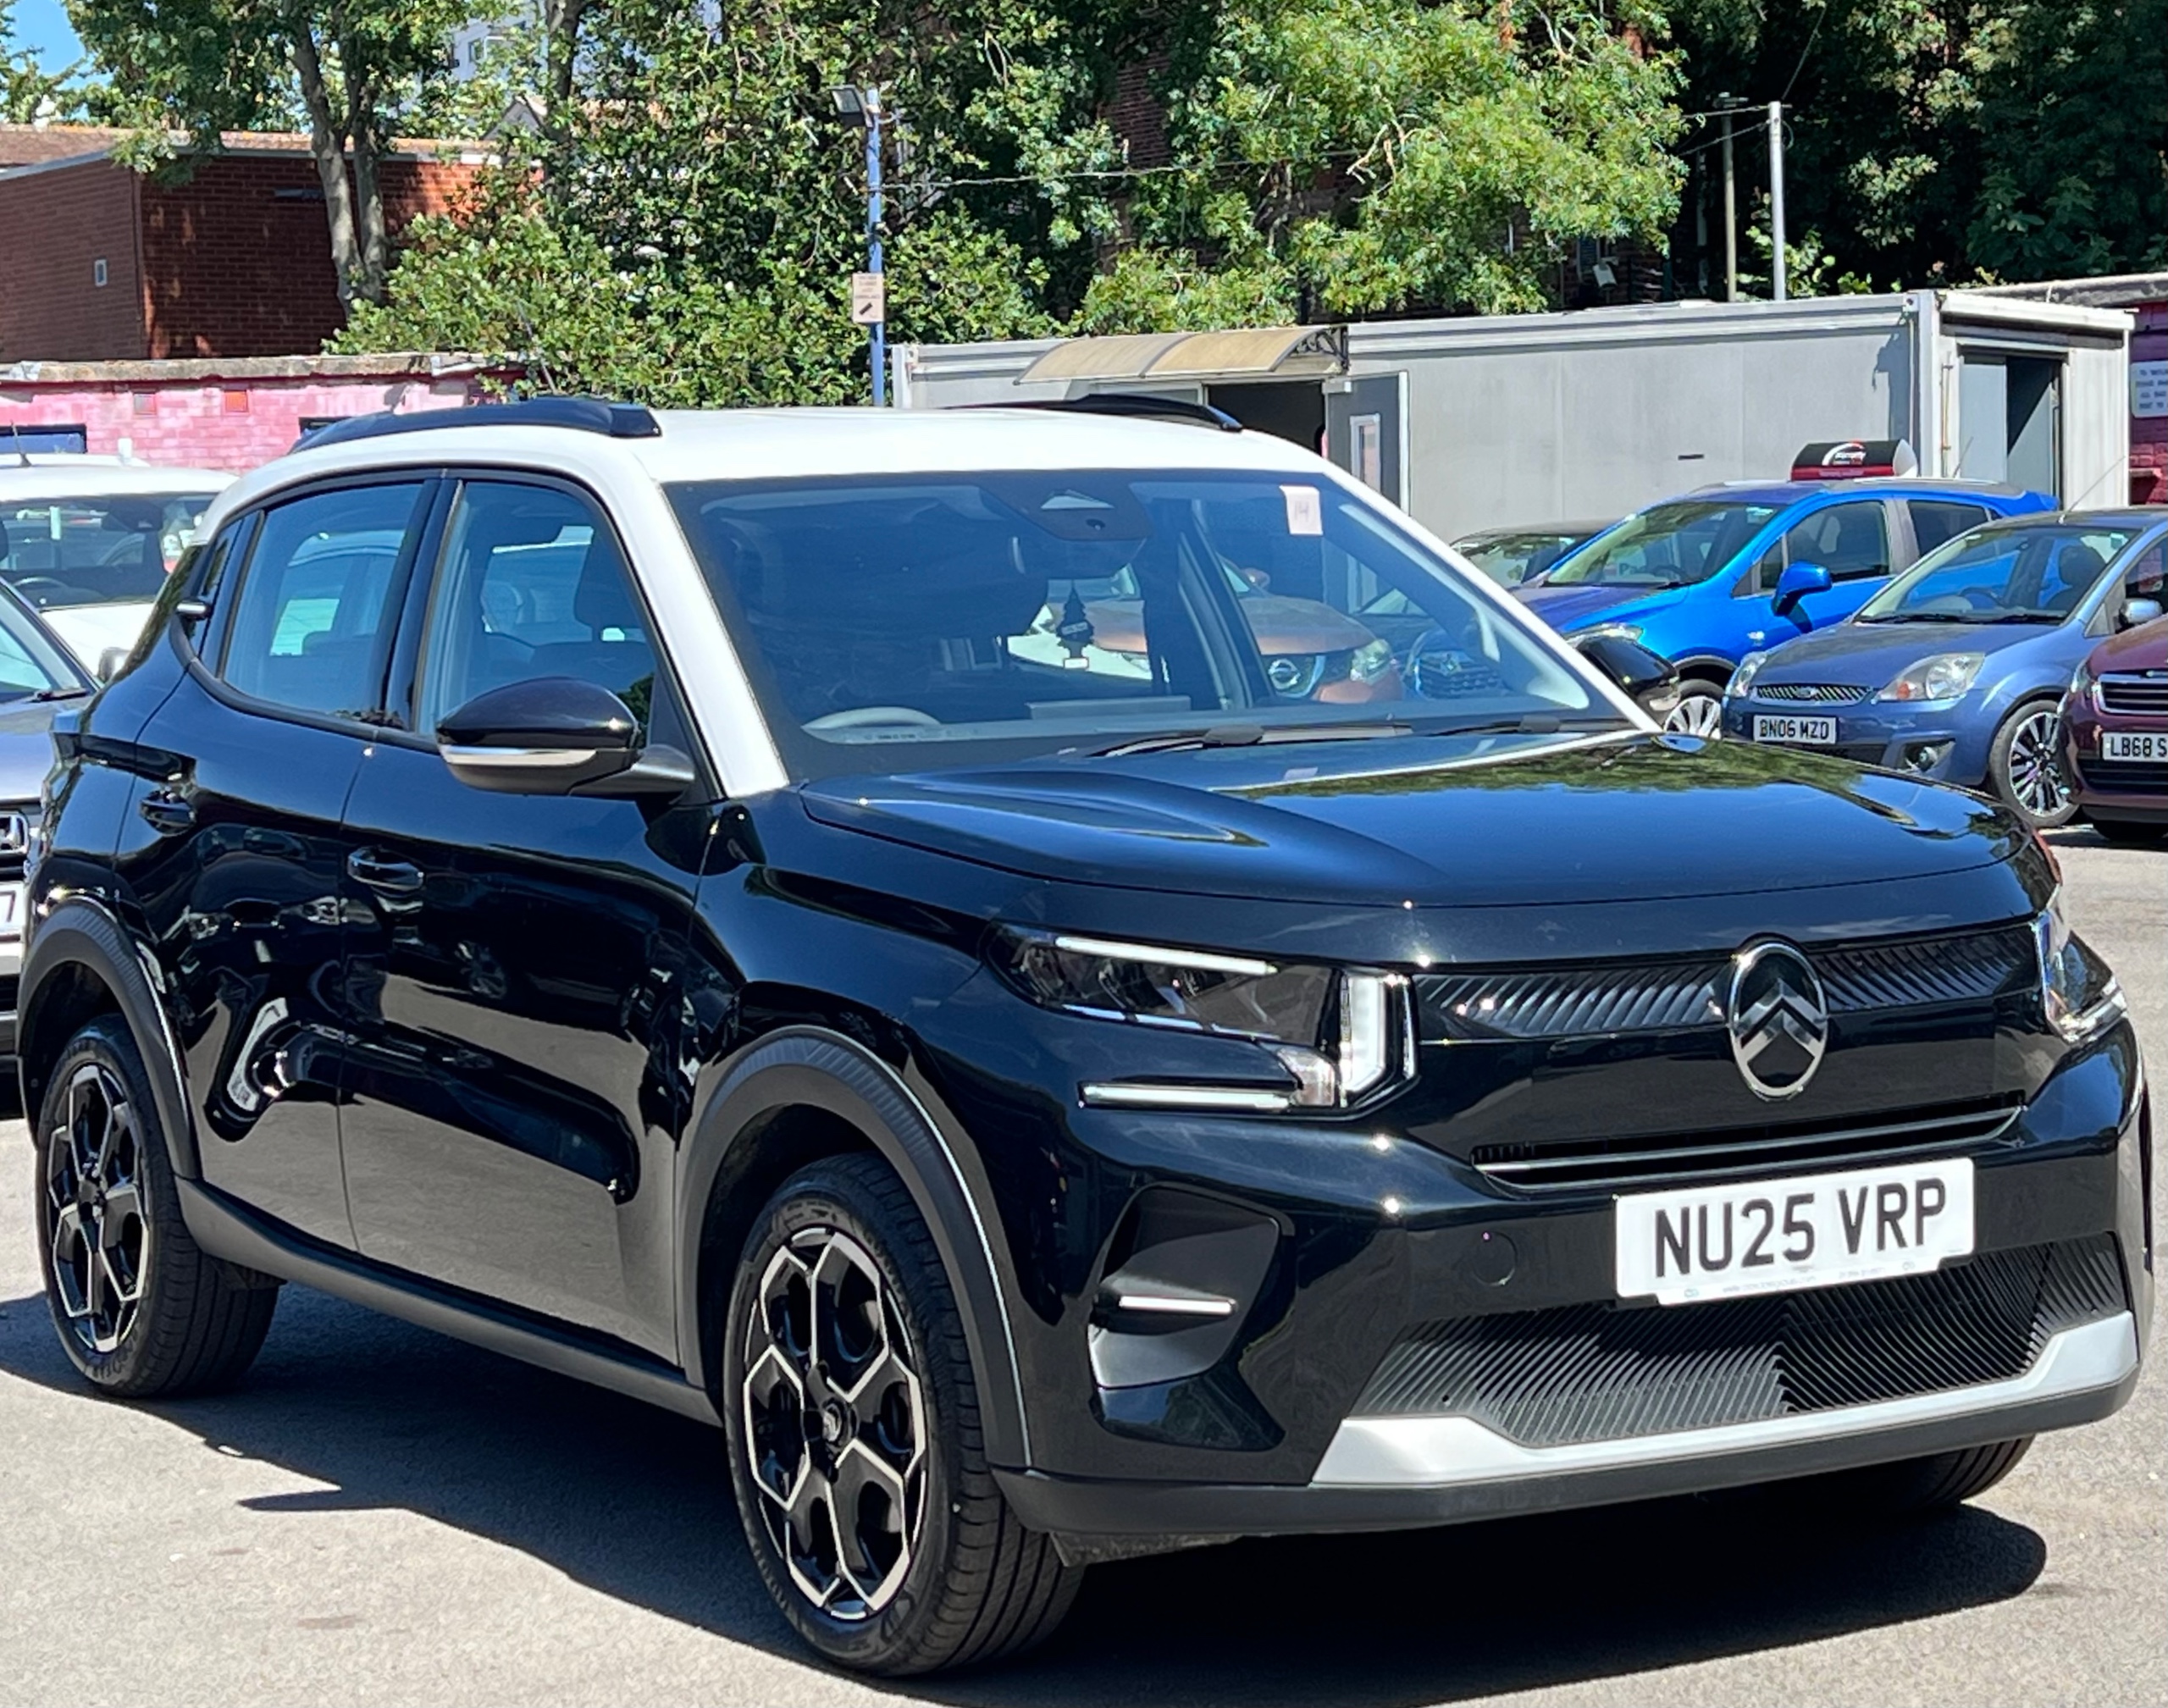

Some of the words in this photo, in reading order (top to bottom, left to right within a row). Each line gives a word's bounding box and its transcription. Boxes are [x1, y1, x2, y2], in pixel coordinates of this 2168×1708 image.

[1759, 719, 1796, 738] BN06
[2110, 736, 2153, 758] LB68
[2156, 737, 2168, 758] S
[1655, 1192, 1816, 1279] NU25
[1838, 1177, 1946, 1255] VRP
